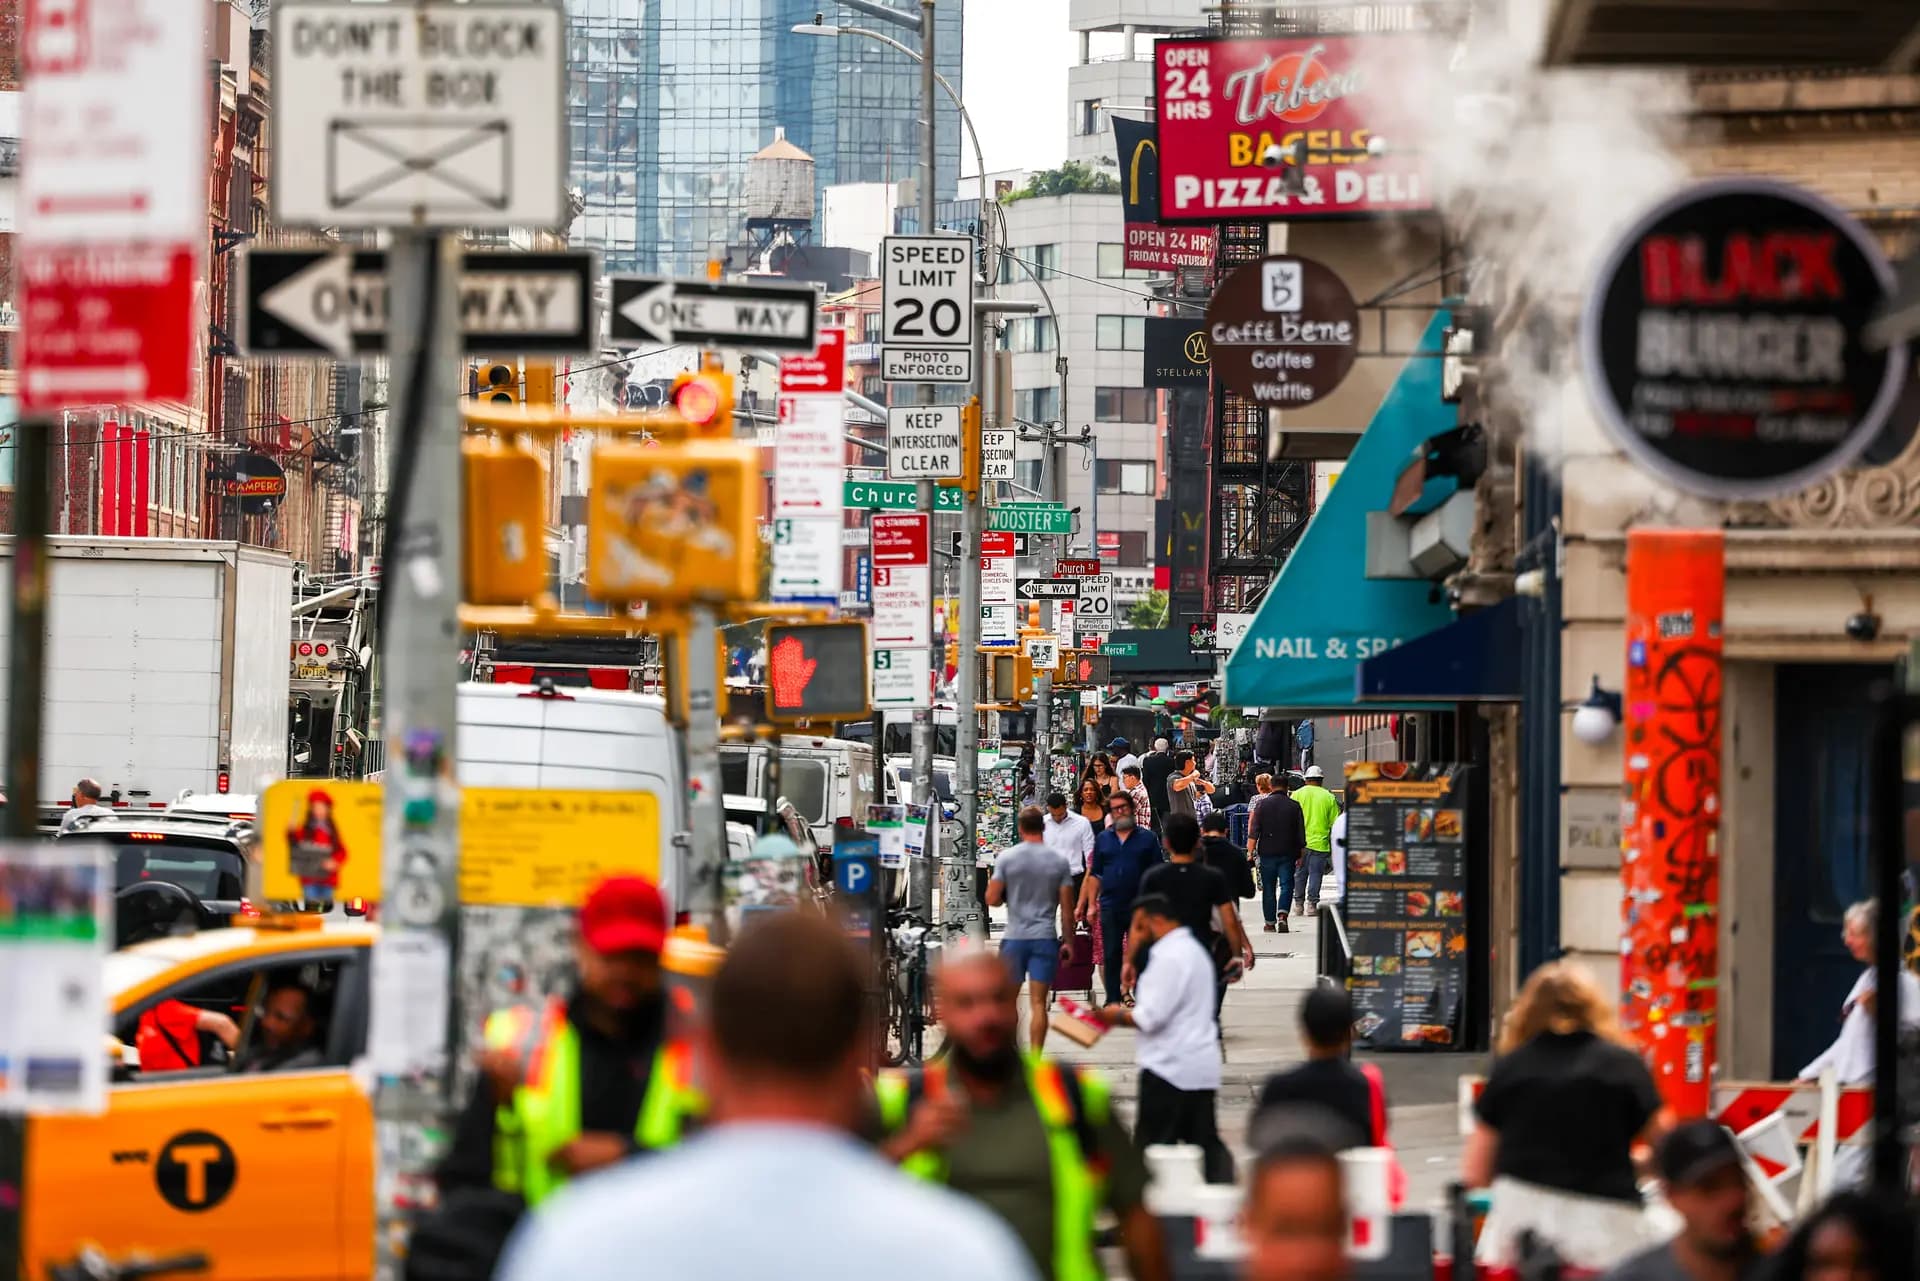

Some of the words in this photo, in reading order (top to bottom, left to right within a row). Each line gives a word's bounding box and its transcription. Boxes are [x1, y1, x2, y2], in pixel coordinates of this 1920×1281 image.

[418, 19, 544, 57] BLOCK
[1165, 48, 1209, 67] OPEN
[341, 68, 404, 106] THE
[425, 70, 501, 106] BOX
[1165, 69, 1211, 100] 24
[1166, 101, 1212, 120] HRS
[1174, 174, 1288, 209] PIZZA
[1297, 175, 1325, 205] &
[1335, 168, 1420, 205] DELI
[1129, 230, 1165, 248] OPEN
[1170, 232, 1187, 250] 24
[892, 246, 965, 264] SPEED
[1129, 251, 1161, 264] FRIDAY
[1162, 254, 1169, 263] &
[898, 269, 957, 287] LIMIT
[311, 278, 388, 326] ON
[651, 300, 704, 329] ONE
[735, 304, 795, 334] WAY
[893, 298, 961, 337] 20
[903, 352, 949, 363] PHOTO
[1251, 351, 1314, 369] Coffee
[889, 364, 963, 376] ENFORCED
[1156, 368, 1202, 377] STELLAR
[1252, 383, 1314, 400] Waffle
[905, 413, 943, 429] KEEP
[891, 434, 958, 449] INTERSECTION
[984, 434, 1004, 445] EEP
[901, 455, 949, 471] CLEAR
[852, 487, 917, 504] Churc
[938, 490, 960, 506] St
[988, 511, 1052, 531] WOOSTER
[1055, 513, 1067, 522] ST
[983, 559, 989, 568] 3
[1057, 562, 1086, 573] Church
[878, 568, 887, 586] 3
[1080, 575, 1110, 584] SPEED
[1025, 585, 1044, 593] ONE
[1052, 585, 1072, 593] WAY
[1081, 585, 1106, 593] LIMIT
[983, 608, 990, 617] 5
[1080, 597, 1108, 614] 20
[1104, 646, 1126, 655] Mercer
[1255, 637, 1318, 659] NAIL
[1325, 637, 1348, 659] &
[878, 651, 888, 669] 5
[848, 863, 866, 890] P
[172, 1144, 220, 1203] T
